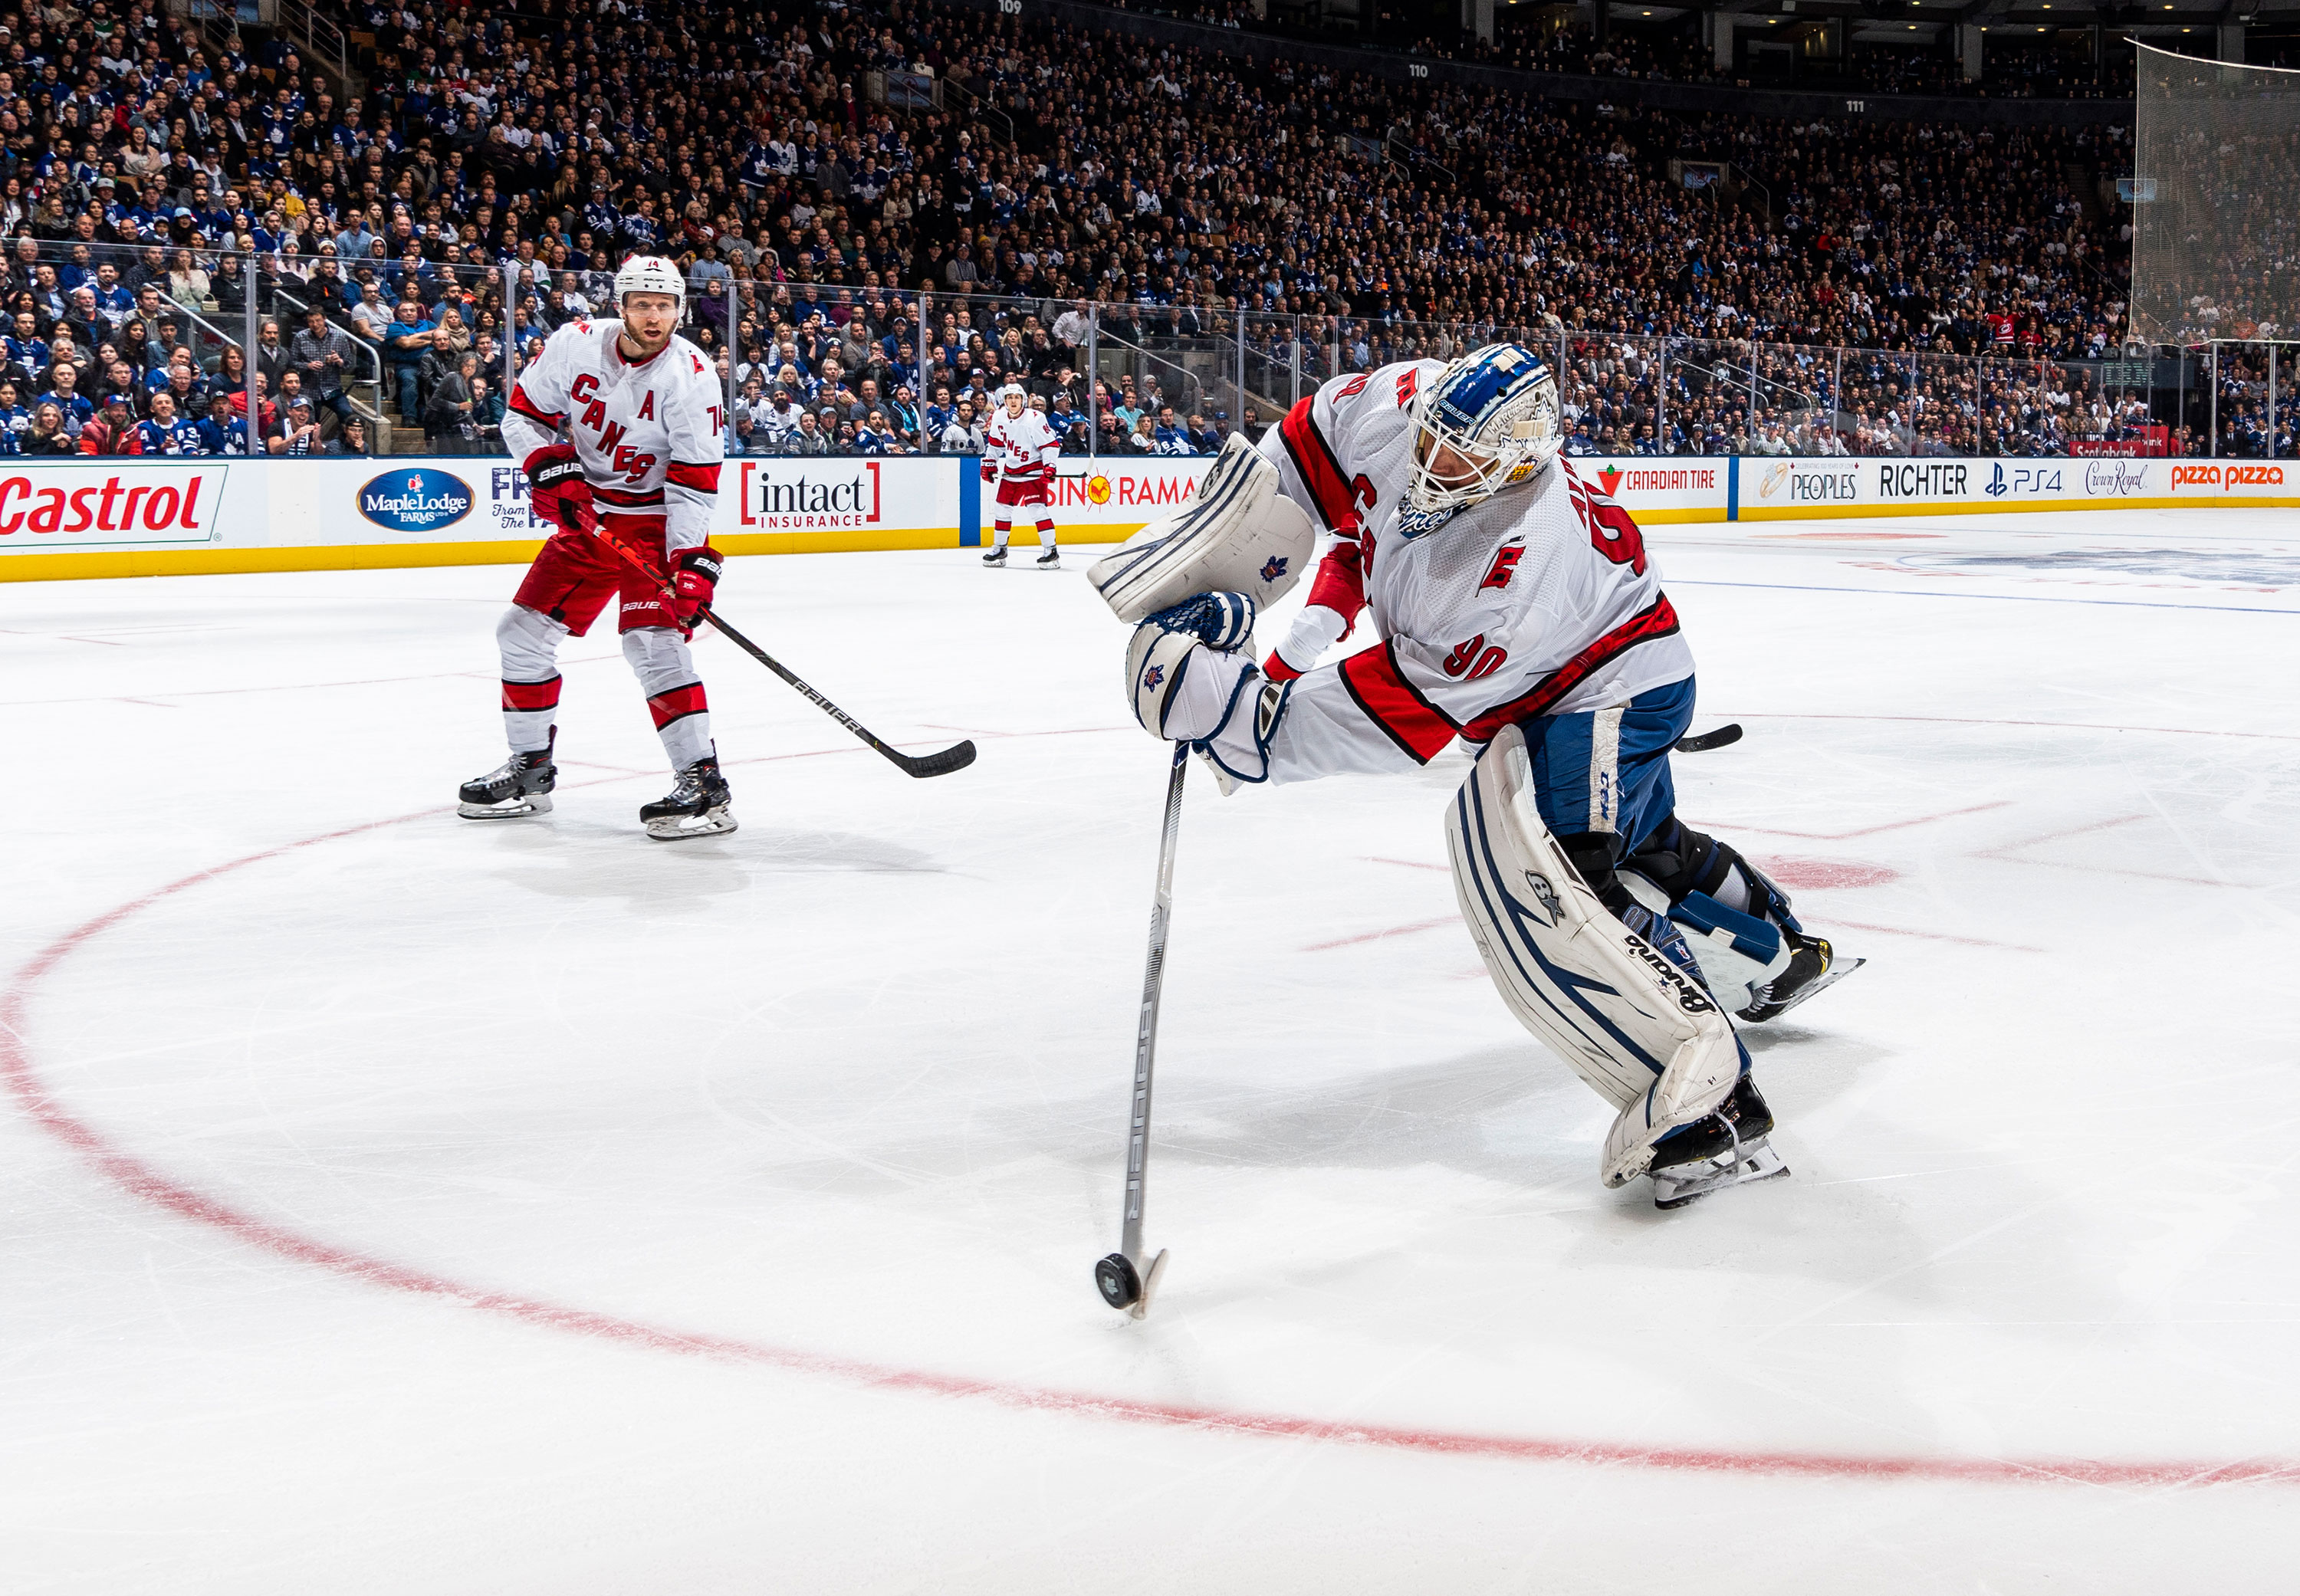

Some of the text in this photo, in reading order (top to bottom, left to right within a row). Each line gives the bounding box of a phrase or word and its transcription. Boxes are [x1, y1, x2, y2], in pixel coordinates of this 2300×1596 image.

[998, 0, 1022, 15] 109
[1409, 64, 1428, 77] 110
[1846, 100, 1864, 112] 111
[2103, 362, 2156, 386] IBM
[637, 389, 655, 422] A
[1437, 399, 1477, 426] BAUER
[1486, 400, 1526, 435] MARLIES
[570, 373, 657, 484] CANES
[997, 425, 1030, 462] CANES
[537, 462, 585, 482] BAUE
[1627, 470, 1715, 491] CANADIAN TIRE
[1881, 465, 1967, 497] RICHTER
[2015, 470, 2062, 492] PS4
[2085, 461, 2148, 495] Crown Royal
[2171, 466, 2284, 491] pizza pizza
[759, 472, 866, 513] intact
[1119, 476, 1198, 506] RAMA
[1791, 475, 1856, 500] PEOPLES
[0, 477, 202, 535] Castrol
[399, 511, 436, 524] FARMS
[491, 504, 527, 517] From
[501, 517, 526, 529] The
[761, 515, 863, 529] INSURANCE
[622, 601, 663, 613] BAUE
[1443, 632, 1508, 681] 90
[793, 680, 863, 733] BAUER
[1127, 1000, 1152, 1220] BAUER
